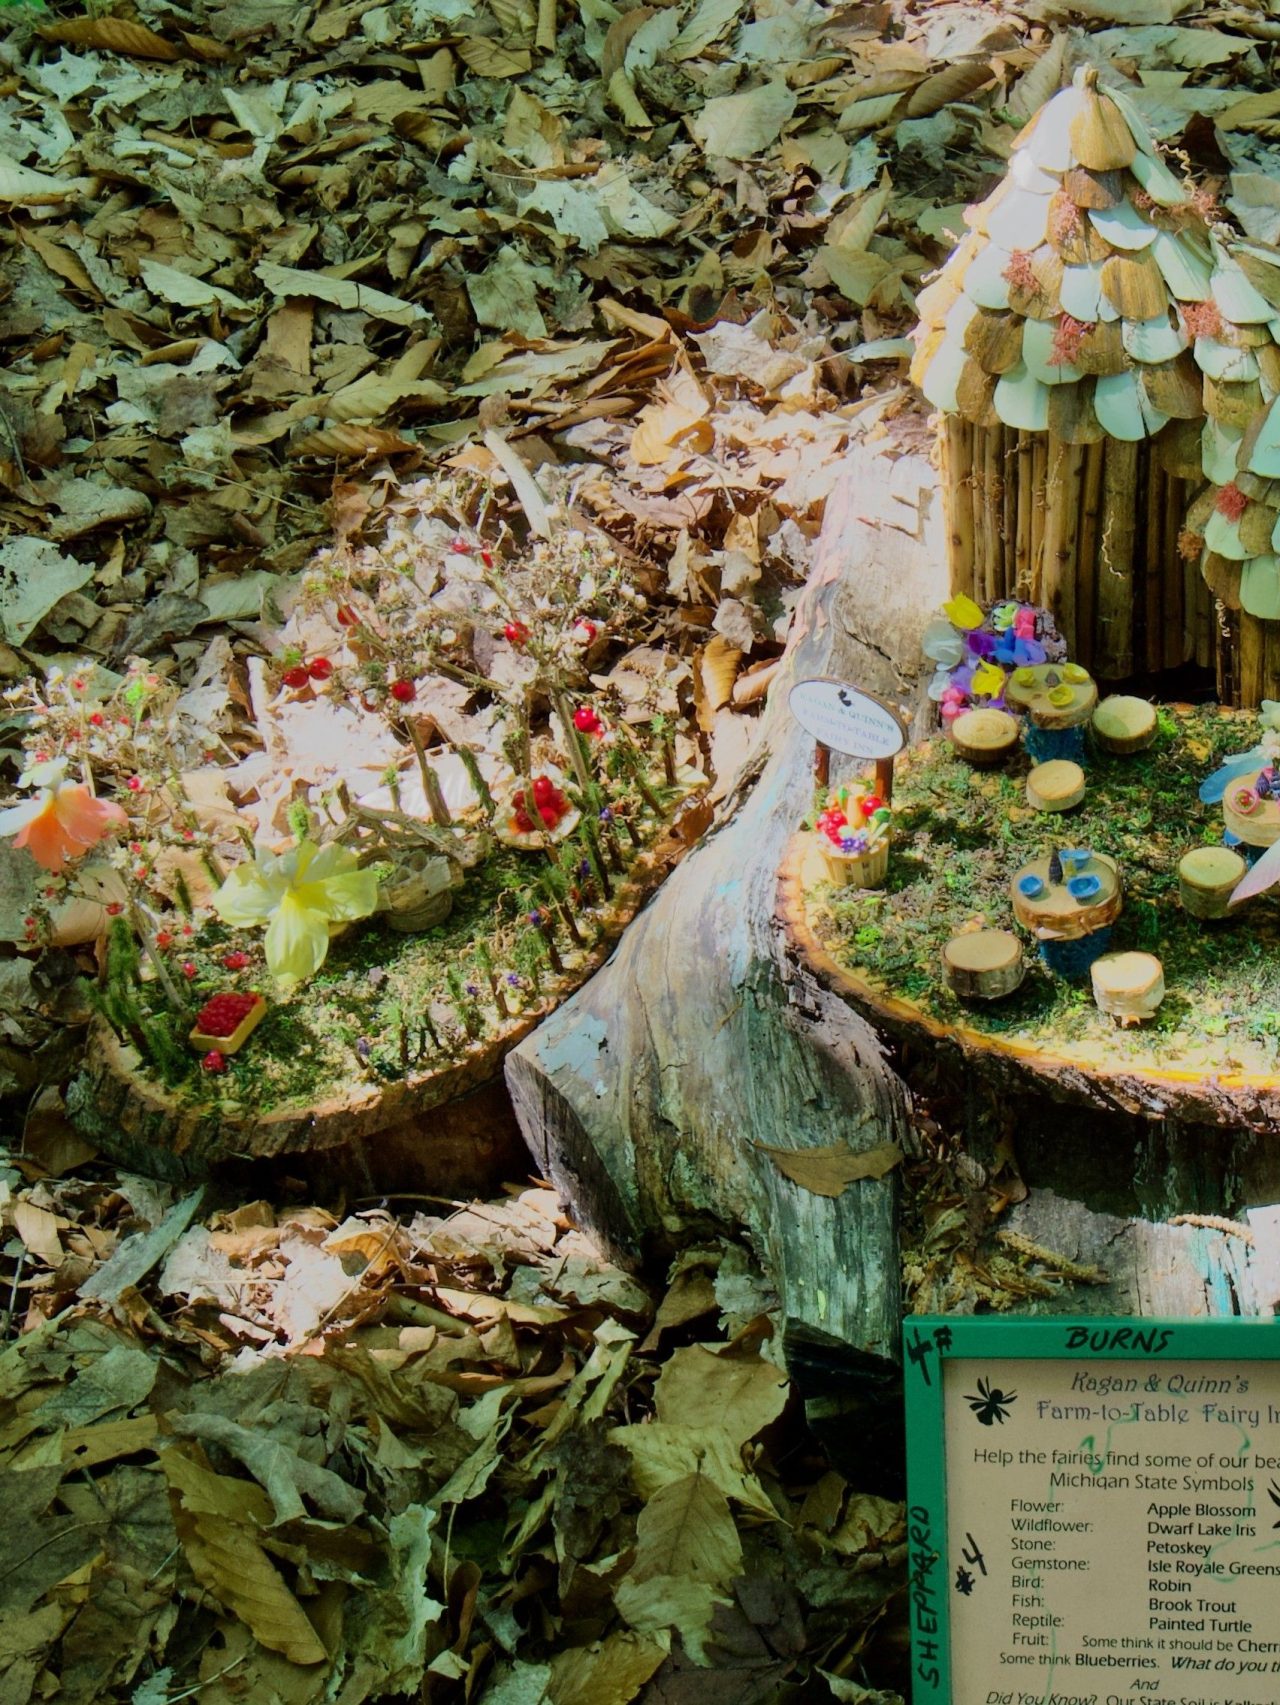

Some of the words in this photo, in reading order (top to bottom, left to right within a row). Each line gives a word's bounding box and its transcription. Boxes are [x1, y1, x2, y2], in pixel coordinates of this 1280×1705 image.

[1065, 1326, 1175, 1354] BURNS
[1071, 1371, 1137, 1396] Kagan
[1143, 1374, 1160, 1392] &
[1167, 1375, 1249, 1394] Quinn's
[1036, 1399, 1190, 1425] Farm-to-Table
[1202, 1403, 1260, 1427] Fairy
[974, 1449, 1013, 1467] Help
[1019, 1450, 1047, 1464] the
[1051, 1449, 1101, 1465] fairies
[1106, 1451, 1139, 1466] find
[1145, 1455, 1192, 1468] some
[1197, 1454, 1216, 1469] of
[1219, 1456, 1249, 1469] our
[1050, 1472, 1129, 1490] Michigan
[1135, 1475, 1178, 1490] State
[1182, 1475, 1255, 1493] Symbols
[1011, 1499, 1064, 1512] Flower:
[1147, 1502, 1191, 1518] Apple
[1195, 1504, 1256, 1517] Blossom
[1011, 1518, 1094, 1532] Wildflower:
[1148, 1521, 1194, 1535] Dwarf
[1198, 1523, 1232, 1536] Lake
[1236, 1523, 1256, 1537] Iris
[1011, 1538, 1056, 1551] Stone:
[1147, 1541, 1212, 1558] Petoskey
[1011, 1557, 1090, 1570] Gemstone:
[1148, 1560, 1172, 1573] Isle
[1176, 1560, 1225, 1577] Royale
[1012, 1576, 1045, 1589] Bird:
[1149, 1579, 1192, 1592] Robin
[909, 1506, 940, 1689] SHEPPARD
[1012, 1595, 1045, 1608] Fish:
[1149, 1598, 1193, 1612] Brook
[1197, 1600, 1237, 1613] Trout
[1012, 1613, 1065, 1629] Reptile:
[1150, 1617, 1205, 1632] Painted
[1208, 1620, 1253, 1633] Turtle
[1012, 1632, 1049, 1646] Fruit:
[1082, 1635, 1118, 1648] Some
[1121, 1637, 1154, 1649] think
[1157, 1637, 1166, 1650] it
[1169, 1639, 1213, 1651] should
[1216, 1640, 1234, 1652] be
[1000, 1653, 1035, 1665] Some
[1039, 1653, 1071, 1666] think
[1075, 1654, 1160, 1669] Blueberries.
[1171, 1656, 1211, 1670] What
[1214, 1657, 1236, 1671] do
[1237, 1660, 1268, 1675] you
[1130, 1678, 1160, 1691] And
[986, 1691, 1013, 1705] Did
[1017, 1693, 1049, 1705] You
[1048, 1693, 1098, 1705] Know?
